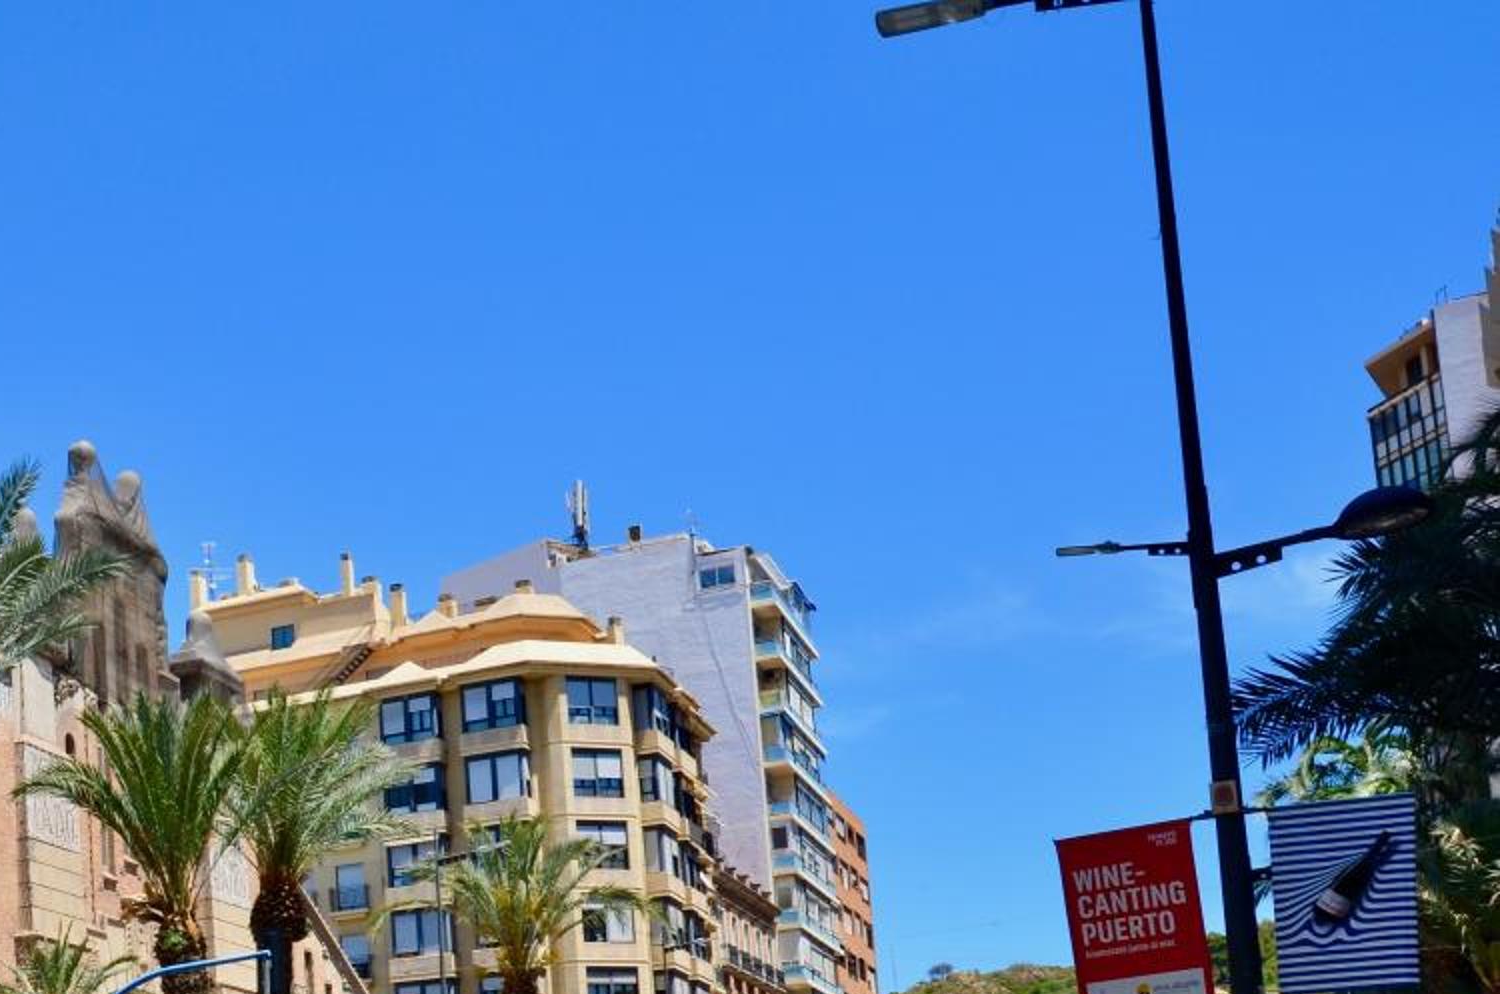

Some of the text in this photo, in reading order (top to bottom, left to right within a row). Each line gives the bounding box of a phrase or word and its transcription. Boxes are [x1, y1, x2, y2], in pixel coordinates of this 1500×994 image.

[1073, 862, 1146, 893] WINE-
[1078, 881, 1188, 919] CANTING
[1081, 911, 1176, 947] PUERTO
